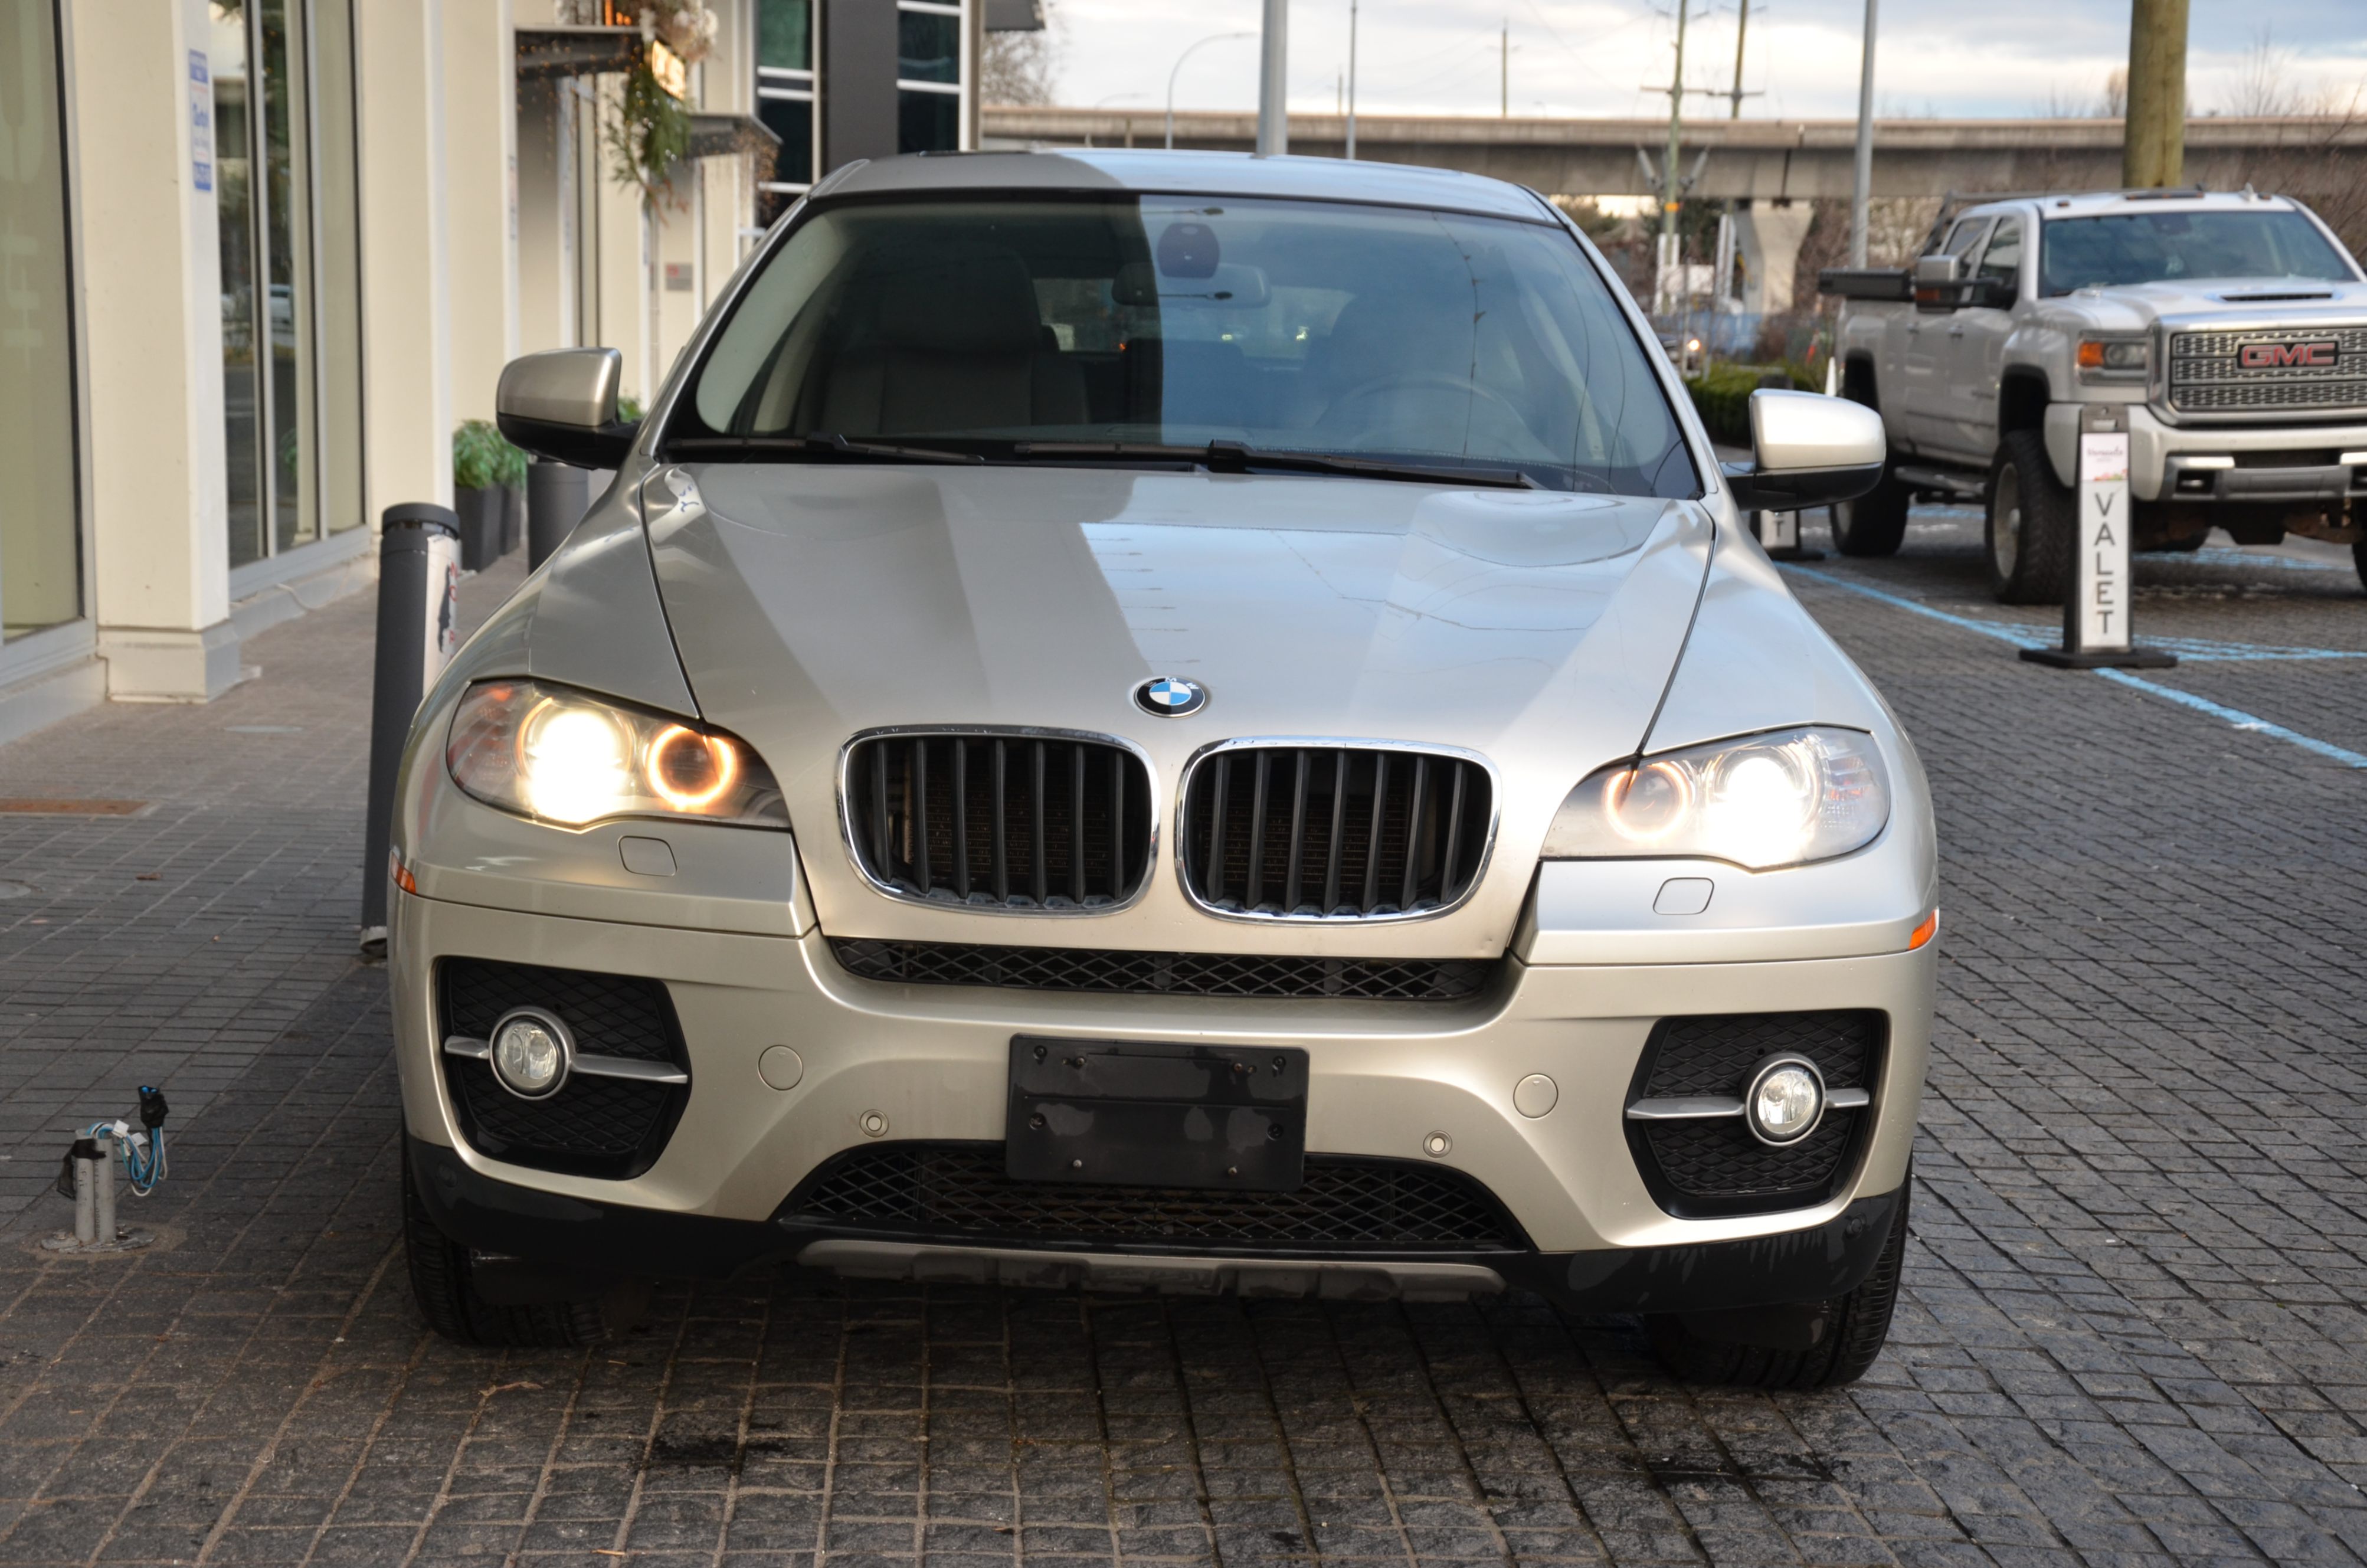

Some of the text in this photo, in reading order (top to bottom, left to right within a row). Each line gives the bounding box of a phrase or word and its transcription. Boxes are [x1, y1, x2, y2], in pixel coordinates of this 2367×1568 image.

[2242, 342, 2336, 368] GMC
[2094, 492, 2116, 634] VALET
[1145, 677, 1200, 689] BMW
